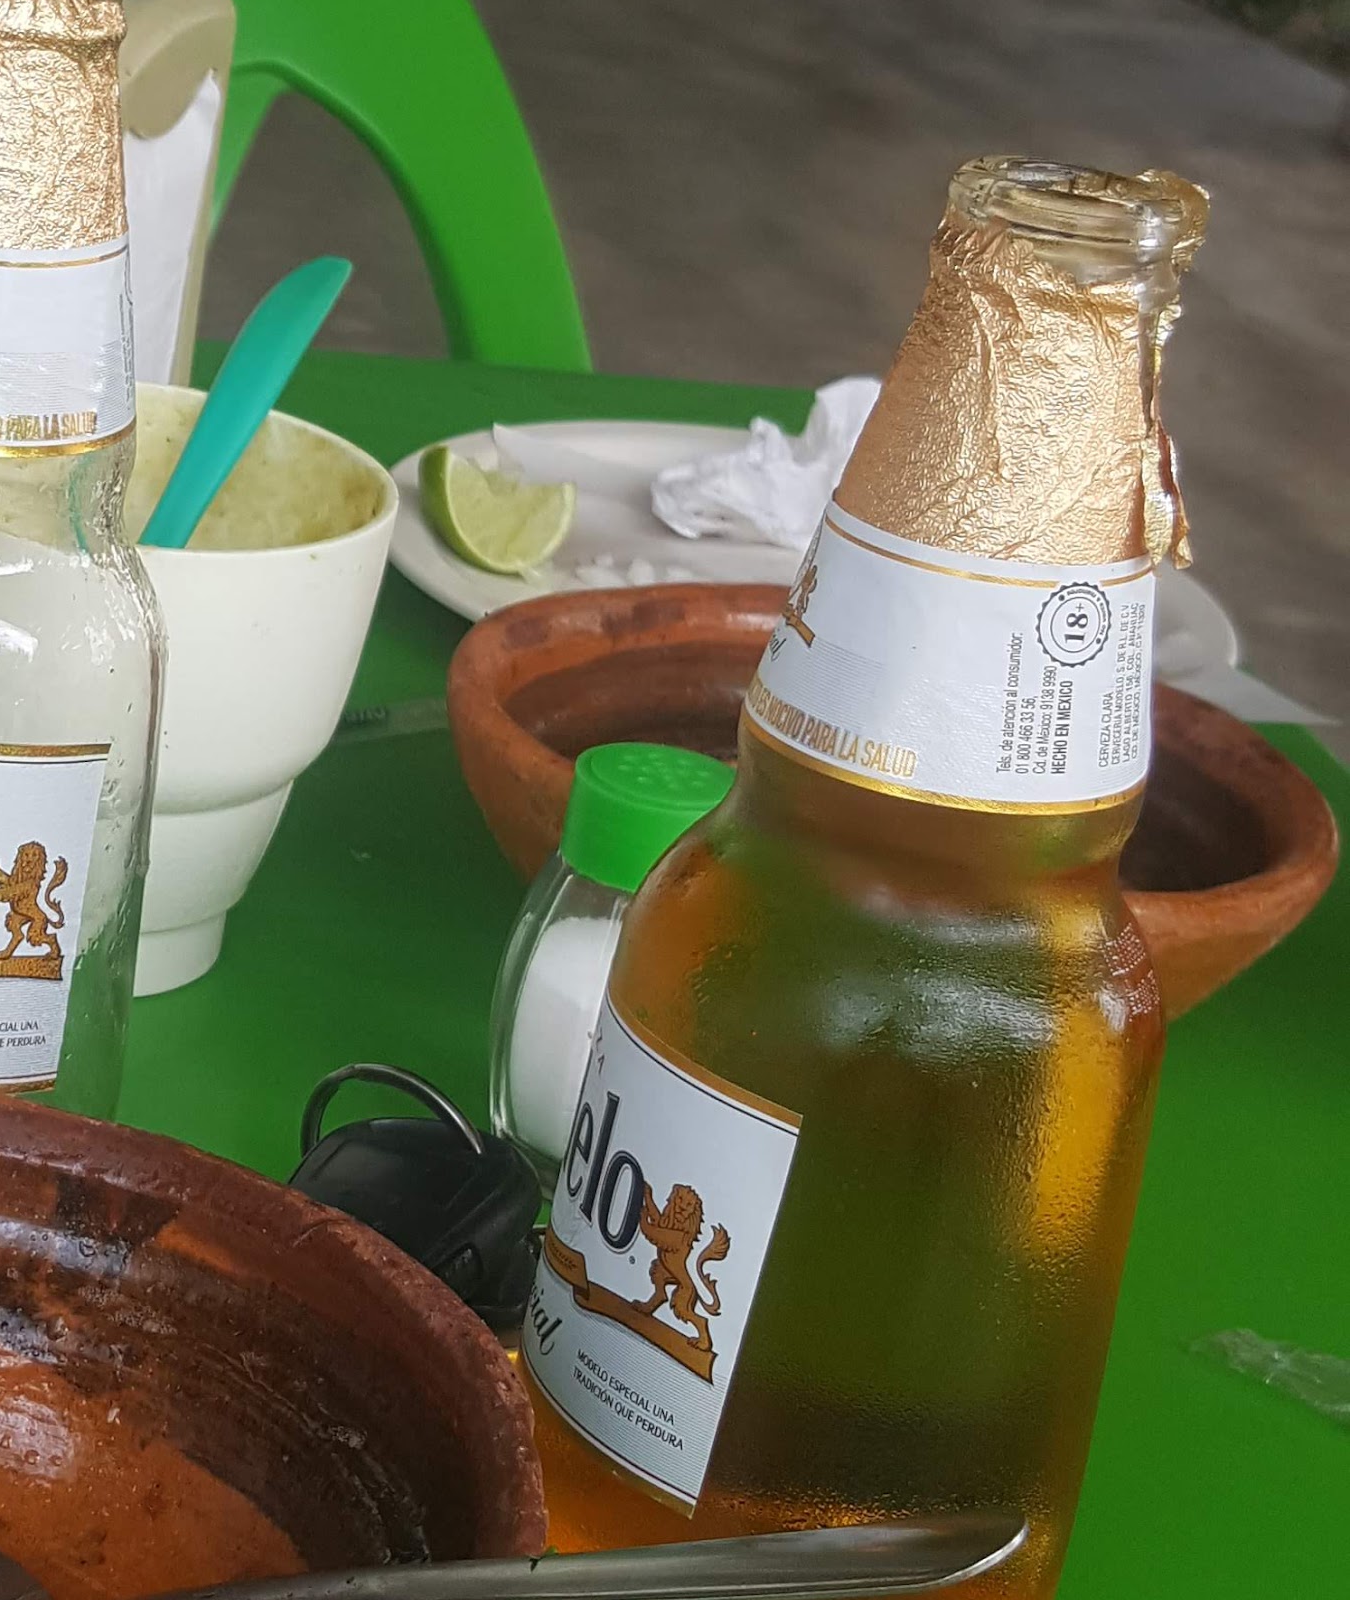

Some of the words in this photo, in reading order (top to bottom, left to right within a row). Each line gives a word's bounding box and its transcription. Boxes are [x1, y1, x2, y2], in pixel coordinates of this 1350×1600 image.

[42, 413, 61, 440] LA
[1041, 665, 1057, 687] 9990
[1003, 689, 1017, 698] al
[1039, 689, 1055, 710] 9138
[1056, 680, 1073, 721] MEXICO
[1020, 711, 1034, 724] 33
[1100, 692, 1113, 723] CLARA
[1000, 700, 1017, 738] atención
[766, 694, 806, 741] NOCIVO
[802, 712, 840, 756] PARA
[837, 729, 860, 763] LA
[860, 739, 918, 777] SALUD
[1019, 724, 1033, 742] 466
[1054, 723, 1070, 737] EN
[998, 739, 1012, 752] de
[1017, 743, 1032, 761] 800
[1035, 745, 1048, 758] de
[1099, 725, 1112, 768] CERVEZA
[996, 754, 1012, 774] Tels.
[1032, 759, 1048, 775] Cd.
[1051, 740, 1069, 774] HECHO
[1016, 763, 1030, 775] 01
[19, 1020, 39, 1031] UNA
[5, 1034, 47, 1048] PERDURA
[564, 1070, 644, 1252] elo
[576, 1348, 609, 1383] MODELO
[608, 1375, 652, 1413] ESPECIAL
[652, 1404, 675, 1426] UNA
[572, 1365, 613, 1408] TRADICIÓN
[614, 1401, 635, 1423] QUE
[635, 1414, 684, 1452] PERDURA
